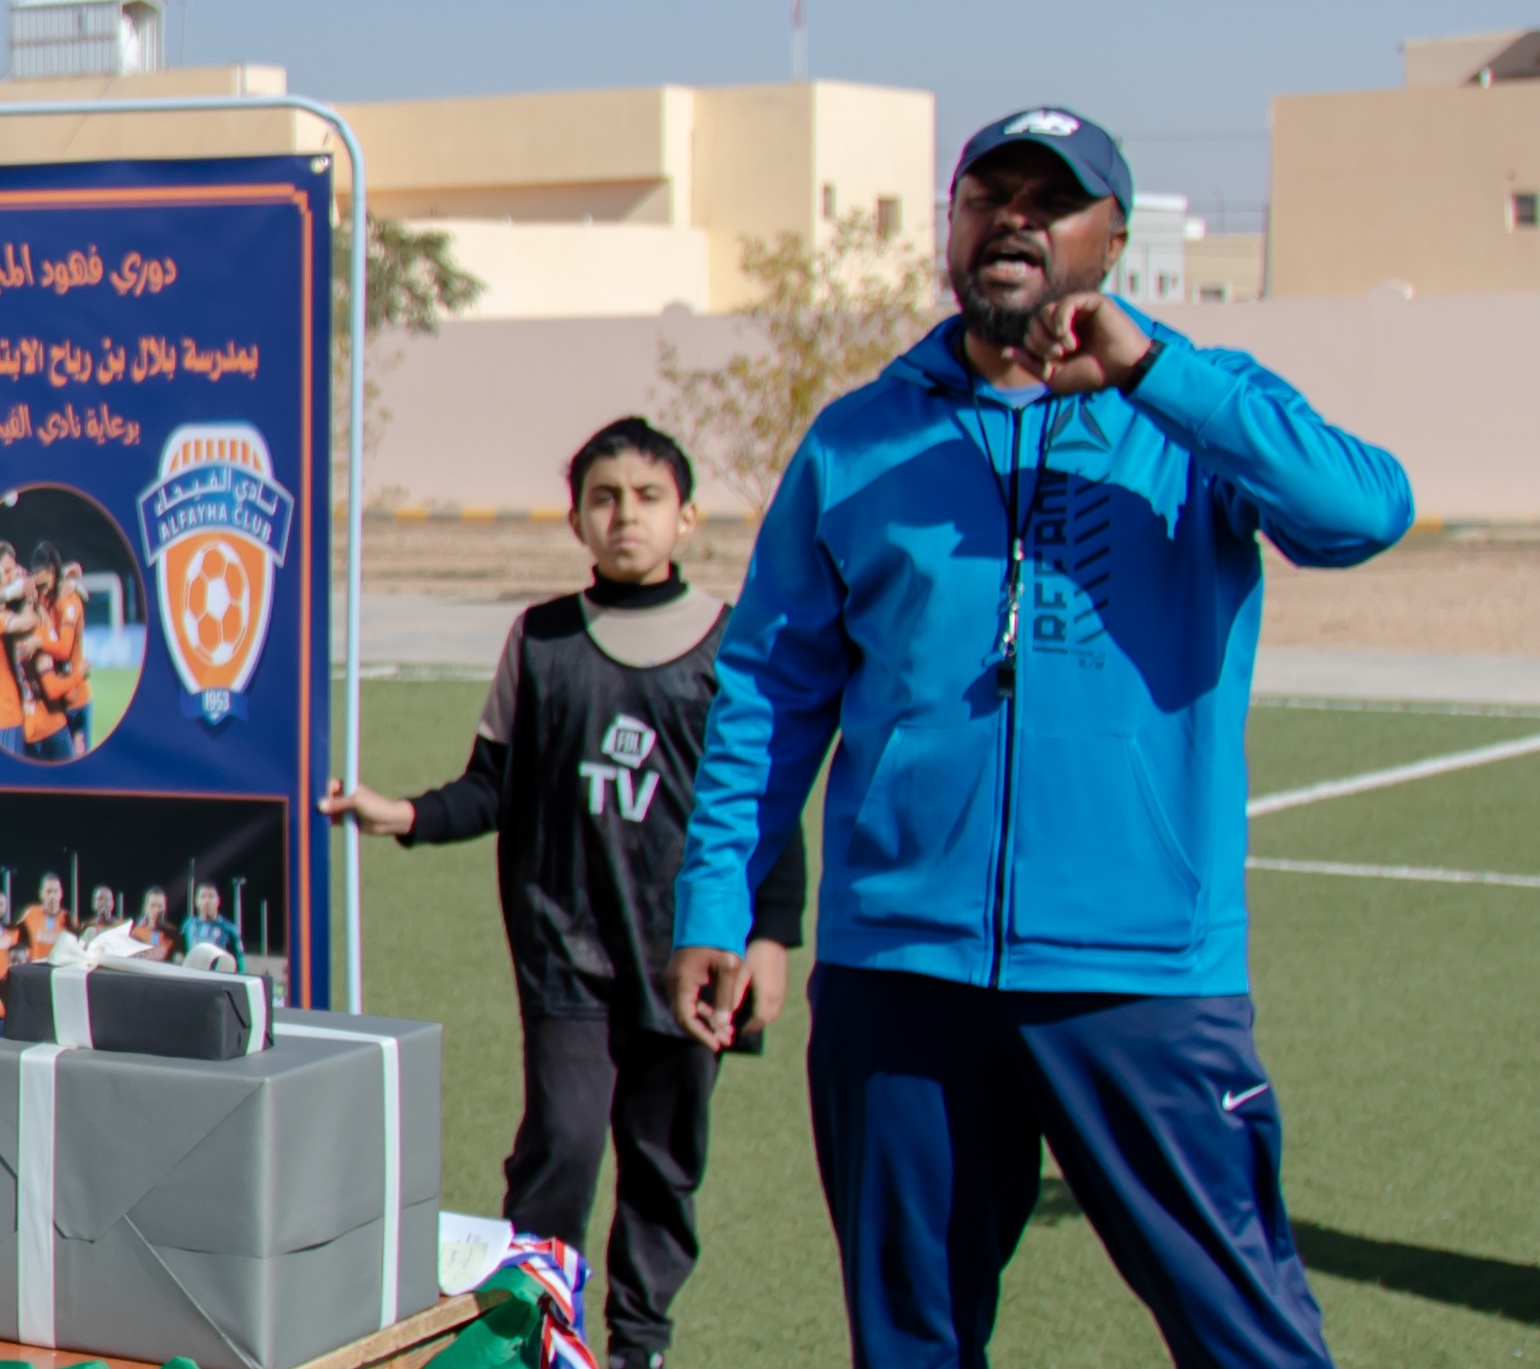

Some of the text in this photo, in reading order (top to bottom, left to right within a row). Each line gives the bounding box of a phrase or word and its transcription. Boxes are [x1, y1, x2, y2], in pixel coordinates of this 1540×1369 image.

[40, 243, 104, 296] فهود
[109, 251, 177, 297] دوري
[49, 338, 93, 387] رباح
[97, 336, 125, 385] بن
[131, 336, 176, 384] بلال
[183, 337, 258, 381] بمدرسة
[37, 403, 81, 446] نادي
[85, 403, 140, 445] برعاية
[153, 467, 279, 518] نادي الفيحاء
[158, 501, 273, 544] ALFAYHA CLUB
[203, 688, 231, 712] 1953
[579, 760, 660, 822] TV
